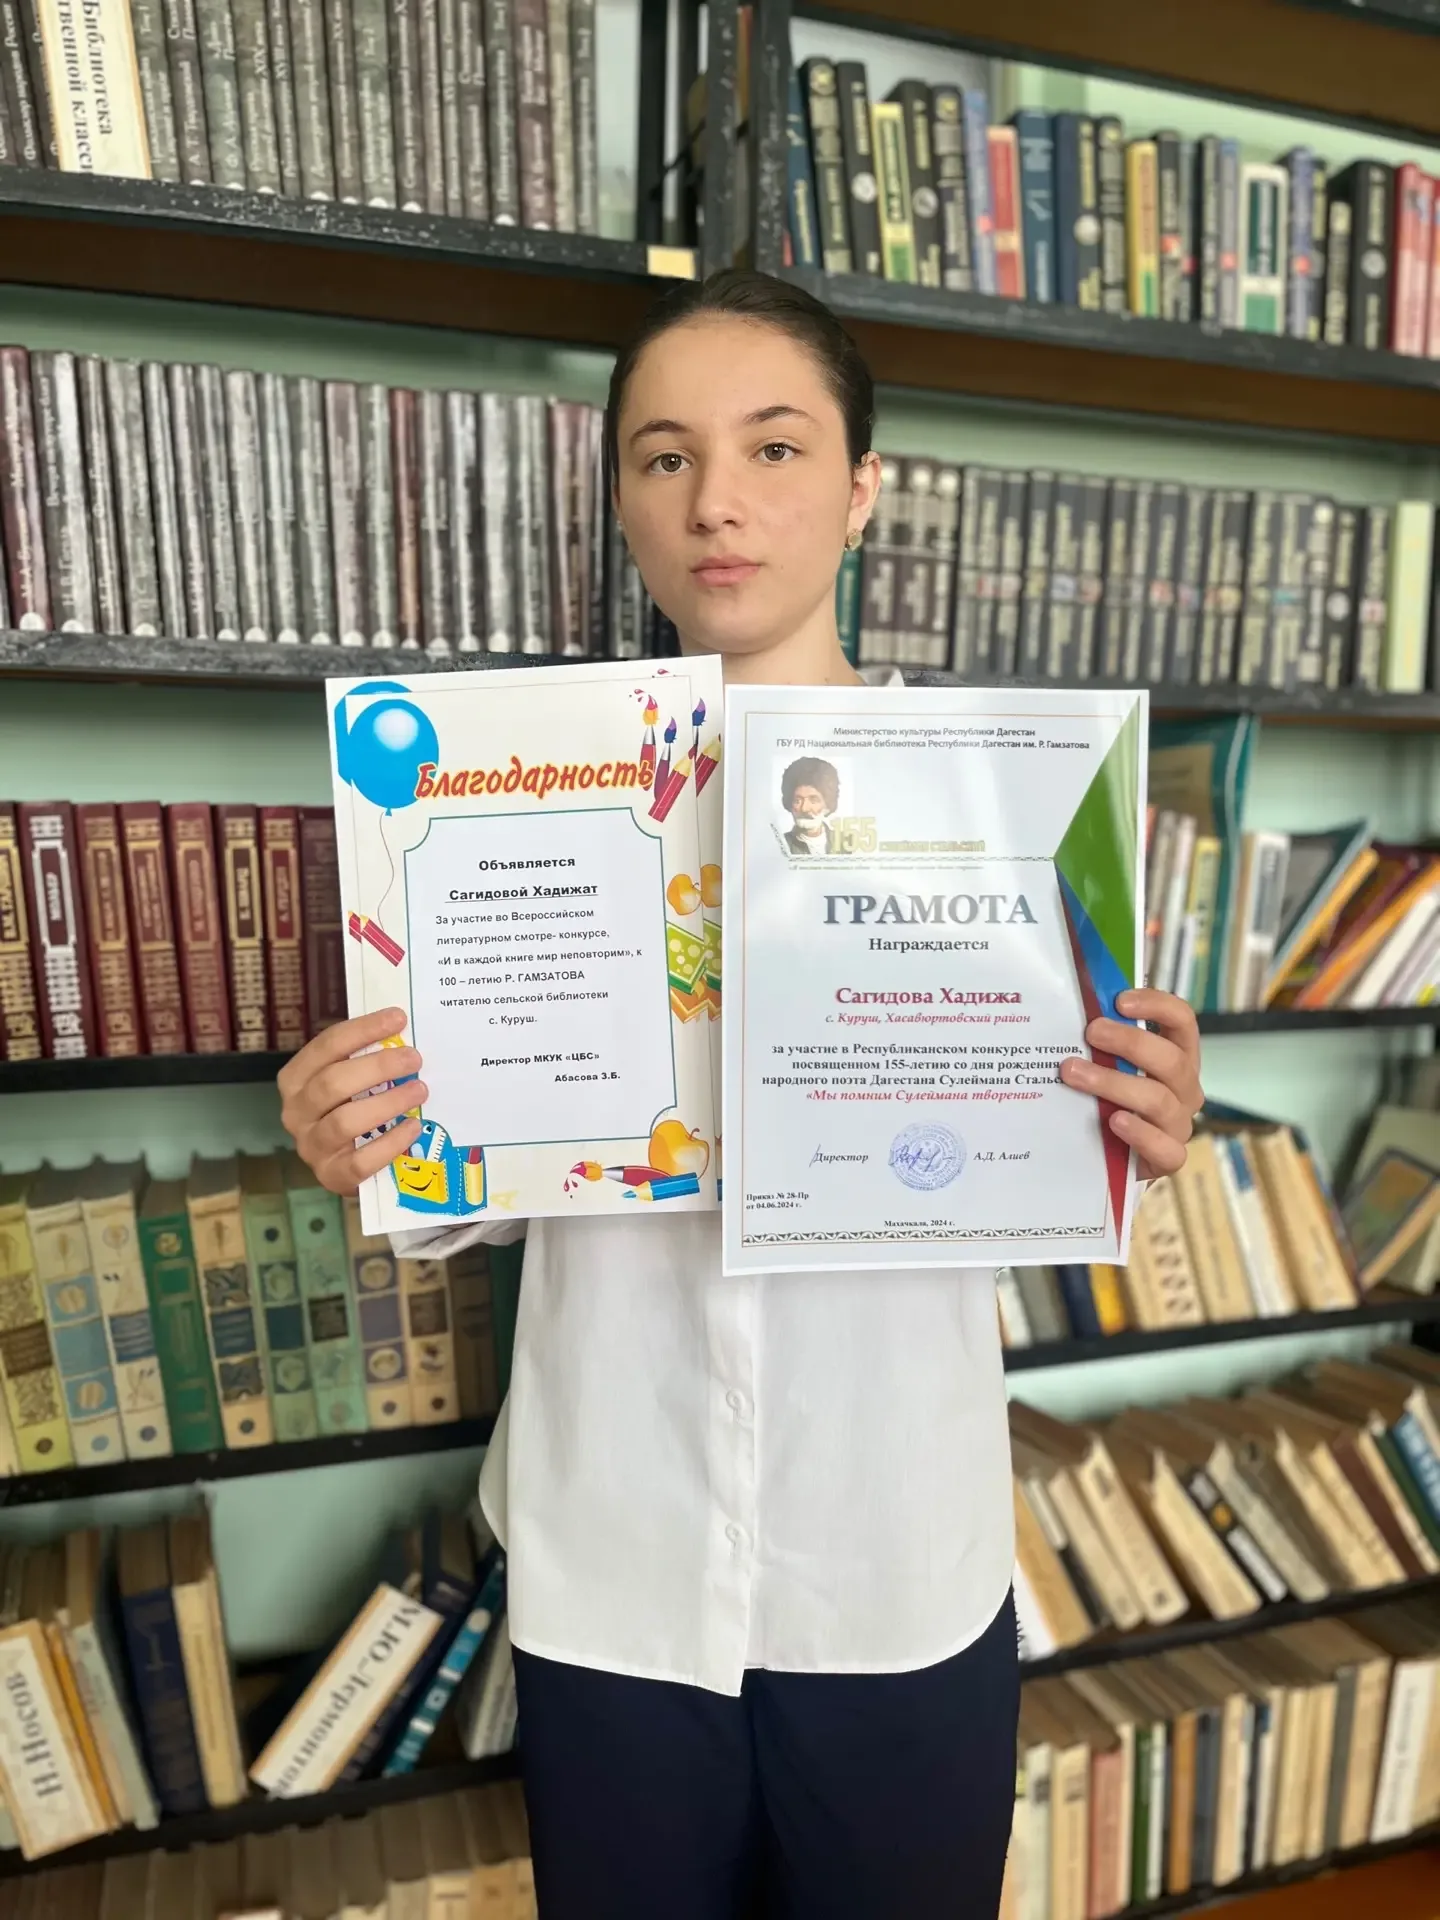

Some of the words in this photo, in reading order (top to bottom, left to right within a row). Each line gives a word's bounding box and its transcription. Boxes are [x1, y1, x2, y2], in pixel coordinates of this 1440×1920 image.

[83, 0, 112, 135] Библиотека
[834, 728, 898, 738] Министерство
[898, 728, 942, 738] культуры
[942, 728, 994, 738] Республики
[996, 728, 1036, 738] Дагестан
[776, 738, 792, 748] ГБУ
[794, 738, 806, 748] РД
[808, 740, 872, 750] Национальная
[874, 738, 926, 748] библиотека
[928, 738, 980, 750] Республики
[982, 740, 1022, 748] Дагестан
[1038, 740, 1046, 748] Р.
[1046, 740, 1090, 750] Гамзатова
[414, 755, 656, 800] Благодарность
[830, 815, 878, 854] 155
[478, 858, 576, 870] Объявляется
[450, 886, 528, 900] Сагидовой
[533, 884, 598, 898] Хадижат
[823, 894, 1038, 925] ГРАМОТА
[436, 916, 448, 924] За
[450, 916, 492, 926] участие
[512, 910, 594, 922] Всероссийском
[436, 934, 512, 946] литературном
[514, 932, 556, 942] смотре-
[558, 930, 610, 940] конкурсе,
[868, 938, 988, 954] Награждается
[438, 956, 450, 966] «И
[464, 954, 502, 964] каждой
[506, 954, 534, 962] книге
[536, 954, 558, 962] мир
[560, 950, 634, 960] неповторим»,
[438, 976, 456, 986] 100
[468, 976, 502, 984] летию
[504, 974, 514, 982] Р.
[518, 970, 584, 982] ГАМЗАТОВА
[440, 998, 492, 1006] читателю
[494, 994, 544, 1004] сельской
[546, 992, 608, 1002] библиотеки
[836, 987, 934, 1006] Сагидова
[939, 987, 1022, 1006] Хадижа
[500, 1016, 538, 1026] Куруш.
[826, 1014, 834, 1022] с.
[838, 1012, 882, 1026] Куруш,
[884, 1012, 990, 1026] Хасавюртовский
[994, 1014, 1030, 1026] район
[772, 1046, 784, 1054] за
[788, 1046, 838, 1056] участие
[854, 1044, 968, 1056] Республиканском
[972, 1046, 1032, 1056] конкурсе
[1034, 1046, 1082, 1054] чтецов,
[480, 1058, 532, 1066] Директор
[534, 1054, 562, 1062] МКУК
[566, 1052, 600, 1062] «ЦБС»
[792, 1062, 880, 1070] посвященном
[886, 1060, 950, 1070] 155-летию
[954, 1062, 968, 1070] со
[970, 1062, 994, 1070] дня
[998, 1062, 1062, 1074] рождения
[554, 1074, 598, 1082] Абасова
[602, 1072, 620, 1080] З.Б.
[762, 1076, 828, 1088] народного
[870, 1074, 936, 1086] Дагестана
[940, 1074, 1010, 1088] Сулеймана
[1014, 1074, 1064, 1085] Стальс
[806, 1090, 836, 1100] «Мы
[840, 1092, 892, 1100] помним
[896, 1090, 968, 1104] Сулеймана
[972, 1090, 1044, 1104] творения»
[814, 1152, 868, 1164] Директор
[973, 1152, 995, 1162] А.Д.
[998, 1151, 1030, 1160] Алиев
[746, 1194, 774, 1202] Приказ
[786, 1192, 810, 1200] 28-Пр
